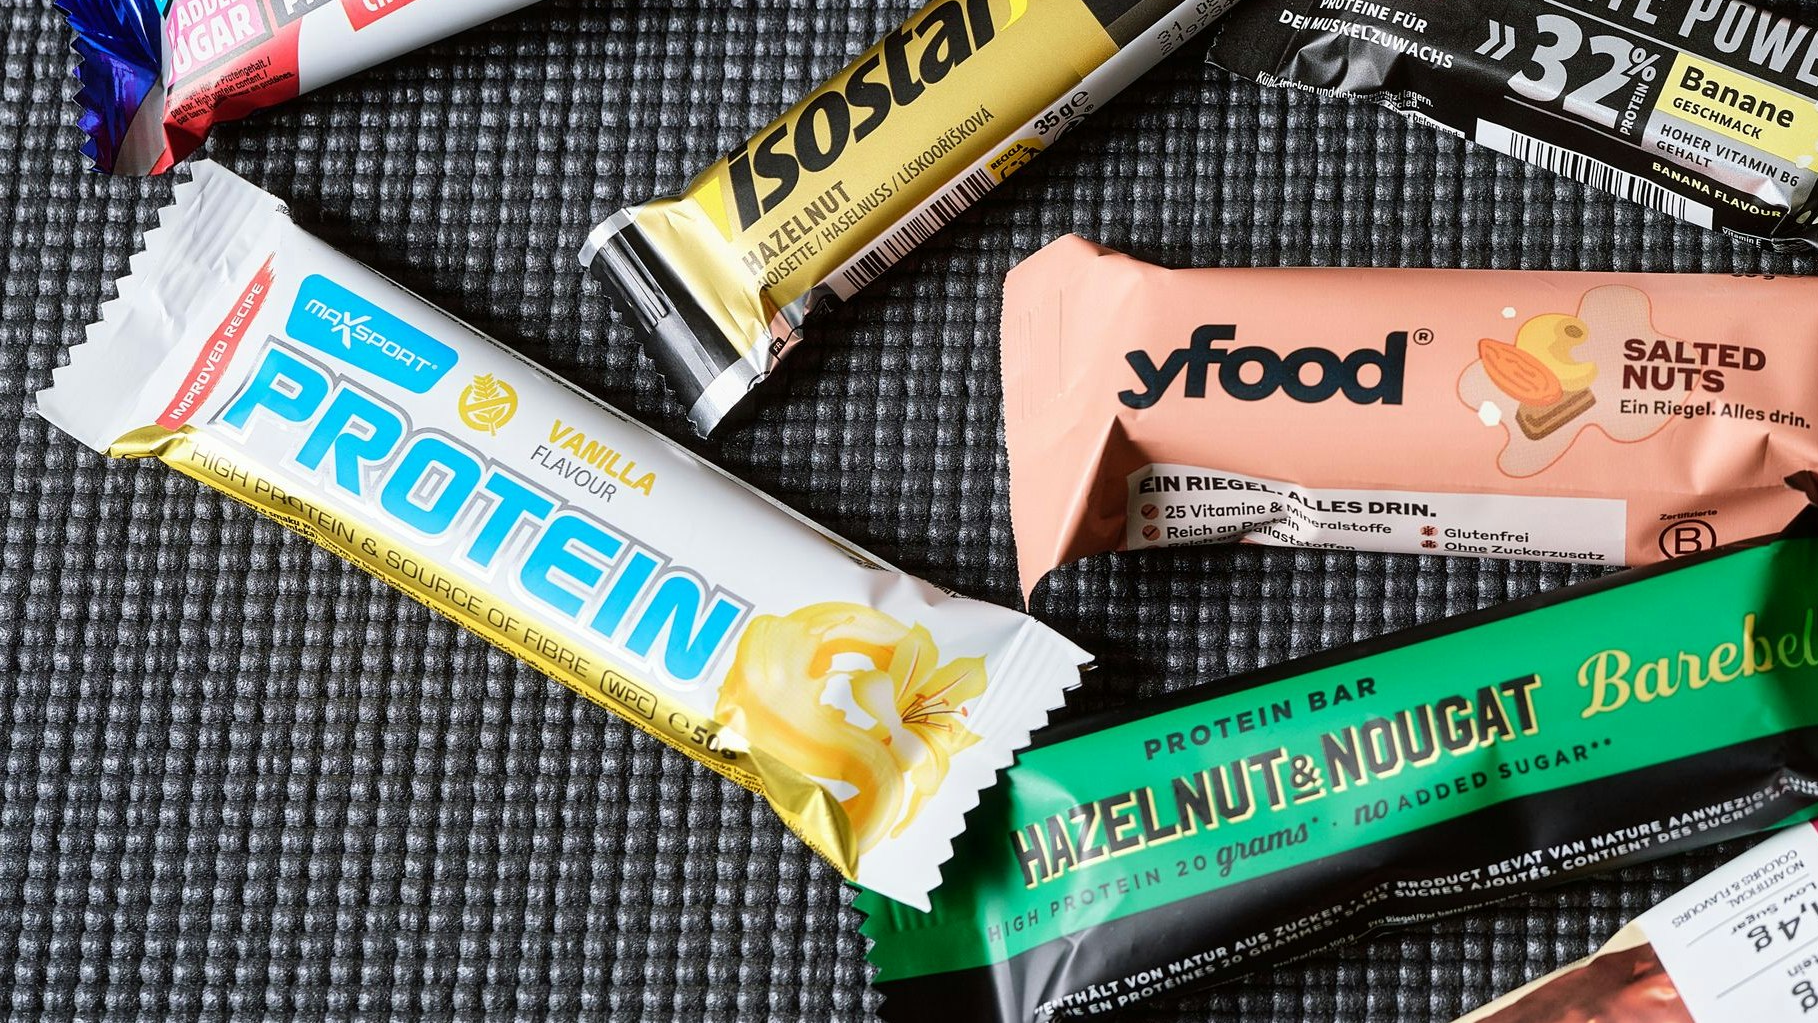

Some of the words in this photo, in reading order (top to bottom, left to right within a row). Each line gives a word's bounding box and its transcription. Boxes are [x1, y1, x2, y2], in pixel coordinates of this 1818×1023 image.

[1278, 8, 1309, 31] DEN
[1397, 8, 1430, 35] FÜR
[1619, 81, 1647, 135] PROTEIN
[1670, 96, 1763, 140] GESCHMACK
[989, 141, 1024, 171] RECICLA
[1655, 139, 1711, 169] GEHALT
[1659, 123, 1712, 154] HOHER
[1713, 143, 1777, 178] VITAMIN
[1650, 162, 1712, 194] BANANA
[740, 180, 854, 275] HAZELNUT
[757, 241, 818, 292] NOISETTE
[820, 182, 894, 244] HASELNUSS
[168, 335, 232, 424] IMPROVED
[222, 280, 266, 337] RECIPE
[1623, 339, 1766, 370] SALTED
[1621, 365, 1726, 393] NUTS
[1619, 399, 1653, 416] Ein
[1657, 400, 1716, 421] Riegel.
[1720, 404, 1768, 424] Alles
[1773, 409, 1811, 429] drin.
[528, 443, 618, 505] FLAVOUR
[543, 419, 661, 497] VANILLA
[1138, 476, 1180, 494] EIN
[1368, 499, 1437, 517] DRIN.
[1189, 499, 1264, 521] Vitamine
[220, 347, 748, 695] PROTEIN
[1443, 526, 1530, 543] Glutenfrei
[1442, 540, 1487, 555] Ohne
[1490, 544, 1605, 562] Zuckerzusatz
[188, 440, 260, 492] HIGH
[259, 479, 361, 546] PROTEIN
[381, 546, 477, 613] SOURCE
[604, 677, 654, 716] WPC
[1144, 699, 1302, 760] PROTEIN
[1309, 676, 1378, 713] BAR
[987, 910, 1042, 943] HIGH
[1050, 870, 1164, 916] PROTEIN
[1396, 772, 1490, 811] ADDED
[1739, 849, 1798, 887] COLOURS
[1780, 881, 1818, 904] Low
[1729, 903, 1778, 935] Sugar
